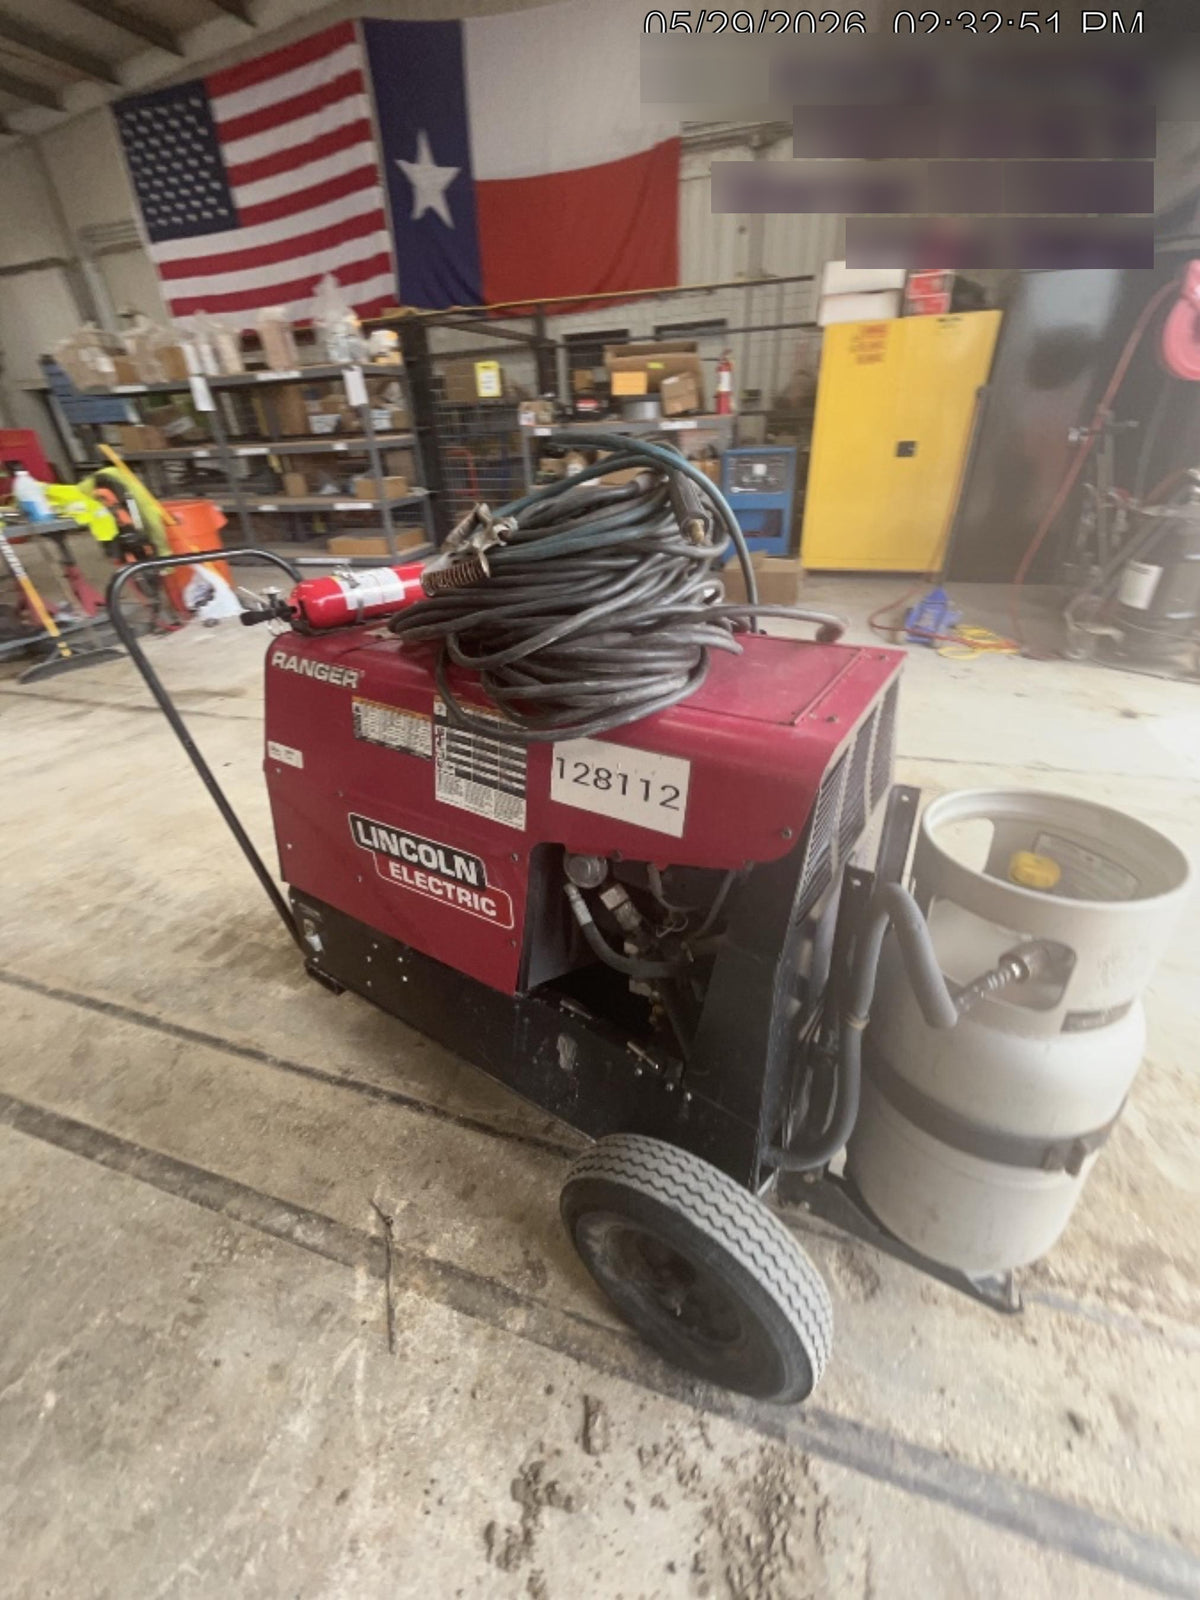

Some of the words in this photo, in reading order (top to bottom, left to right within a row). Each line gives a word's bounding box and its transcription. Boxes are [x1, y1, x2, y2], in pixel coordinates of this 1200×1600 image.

[271, 650, 360, 689] RANGER
[556, 756, 680, 812] 128112
[356, 820, 480, 887] LINCOLN
[388, 860, 498, 917] ELECTRIC
